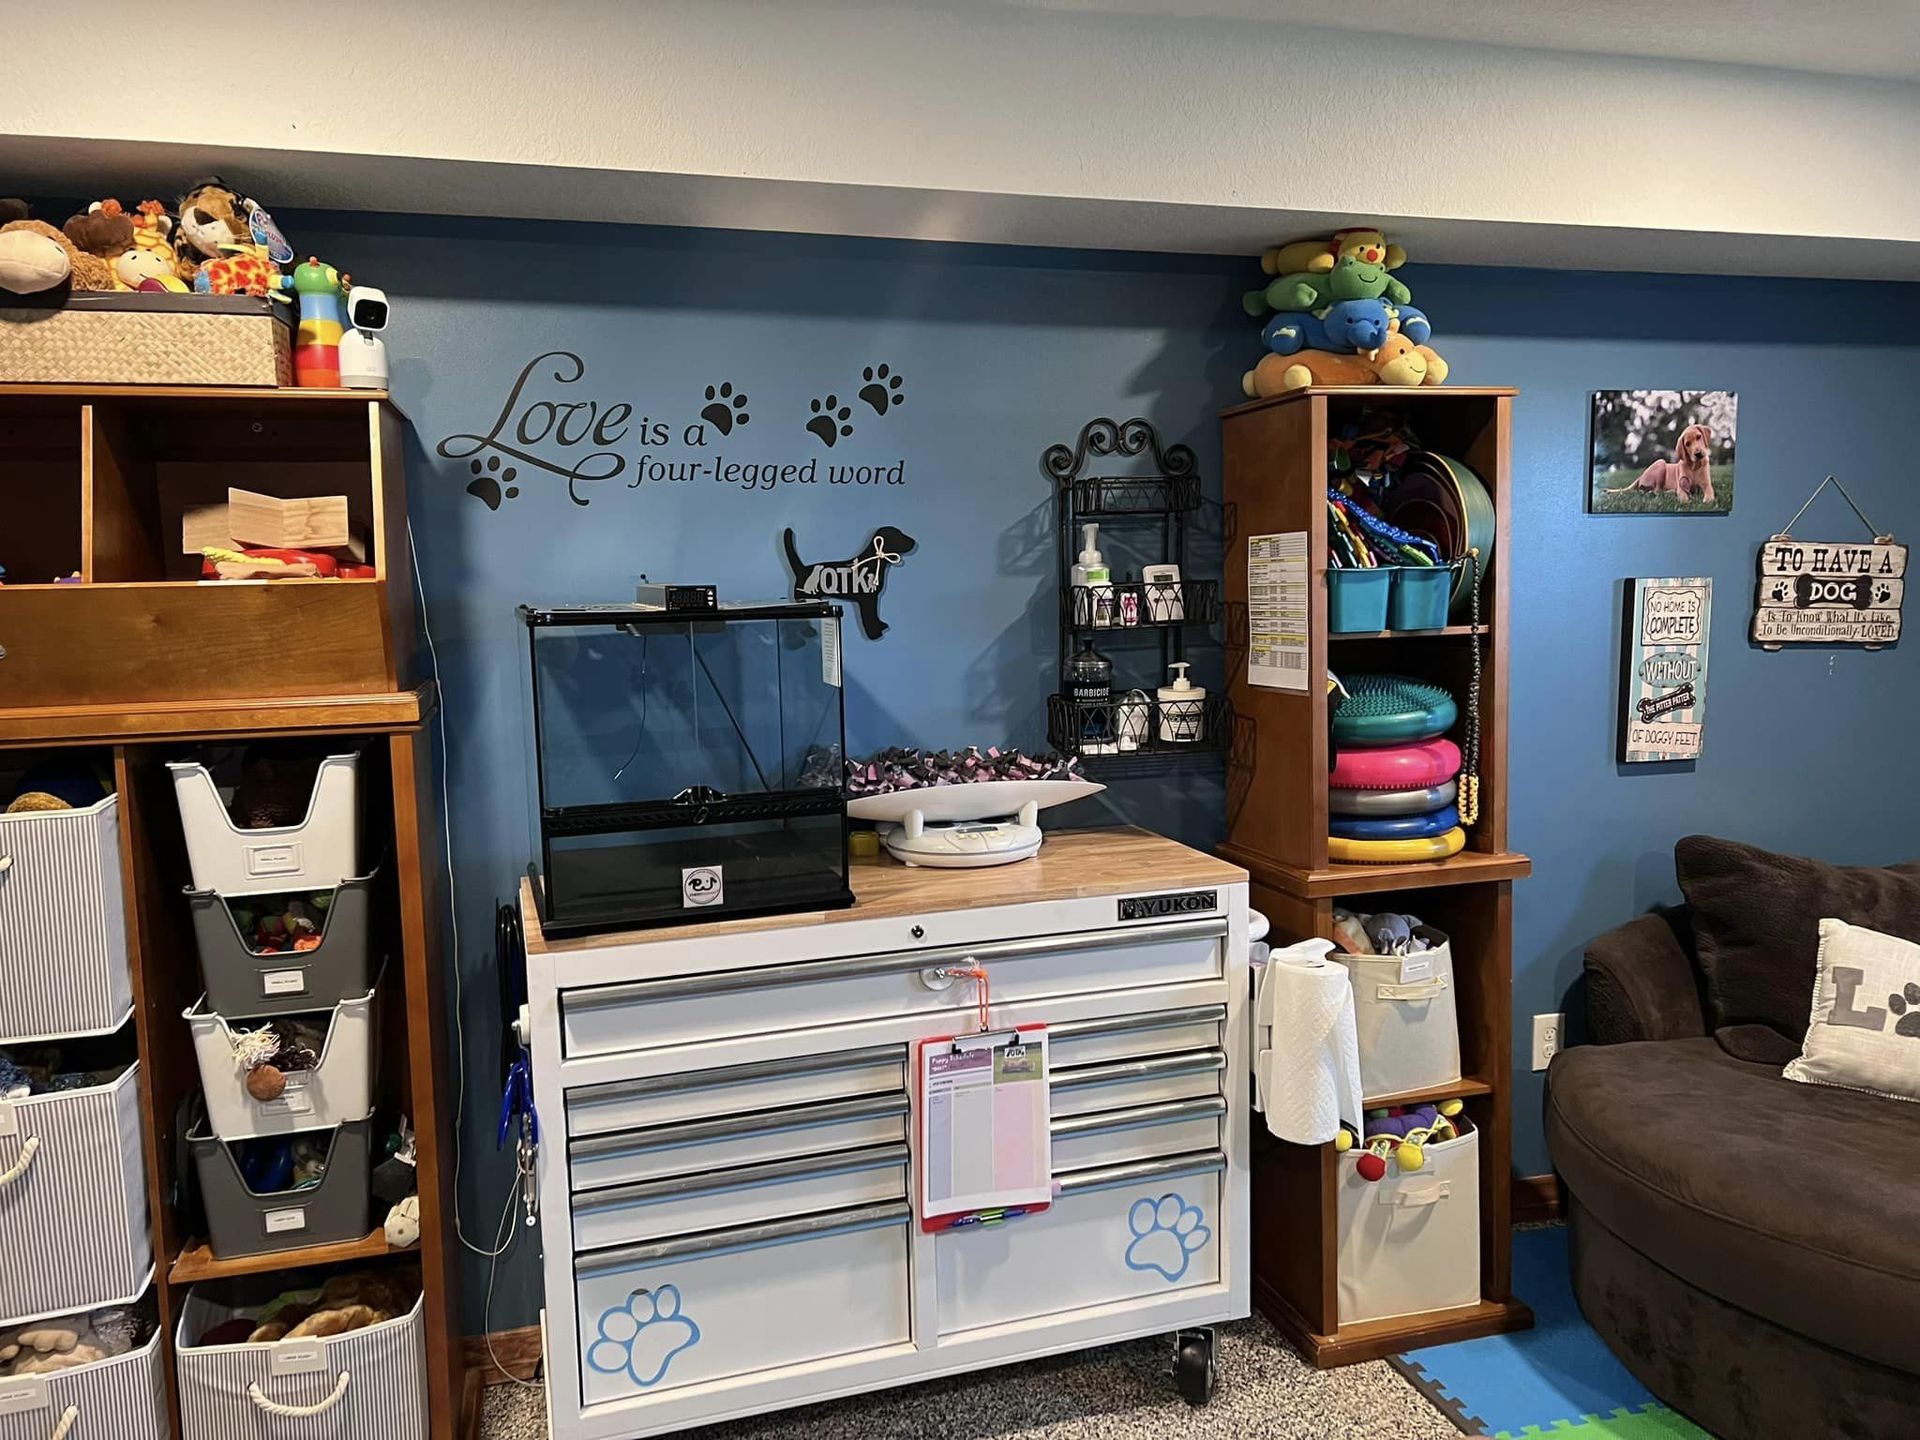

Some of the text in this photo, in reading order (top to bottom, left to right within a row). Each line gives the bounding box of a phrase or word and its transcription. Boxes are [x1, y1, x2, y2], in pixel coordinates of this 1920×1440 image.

[437, 351, 707, 506] Love is a
[627, 455, 906, 490] four-legged word
[1775, 547, 1893, 573] TO HAVE A
[820, 567, 870, 594] QTK
[1809, 582, 1857, 601] DOG
[1650, 600, 1696, 614] NO HOME IS
[1650, 616, 1695, 635] COMPLETE
[1767, 611, 1776, 623] Is
[1780, 611, 1792, 623] To
[1796, 611, 1822, 623] Know
[1826, 611, 1849, 623] What
[1776, 624, 1787, 636] Be
[1645, 660, 1697, 681] WITHOUT
[1073, 687, 1110, 698] BARBICIDE
[1632, 729, 1697, 746] OF DOGGY FEET
[1143, 895, 1215, 915] YUKON
